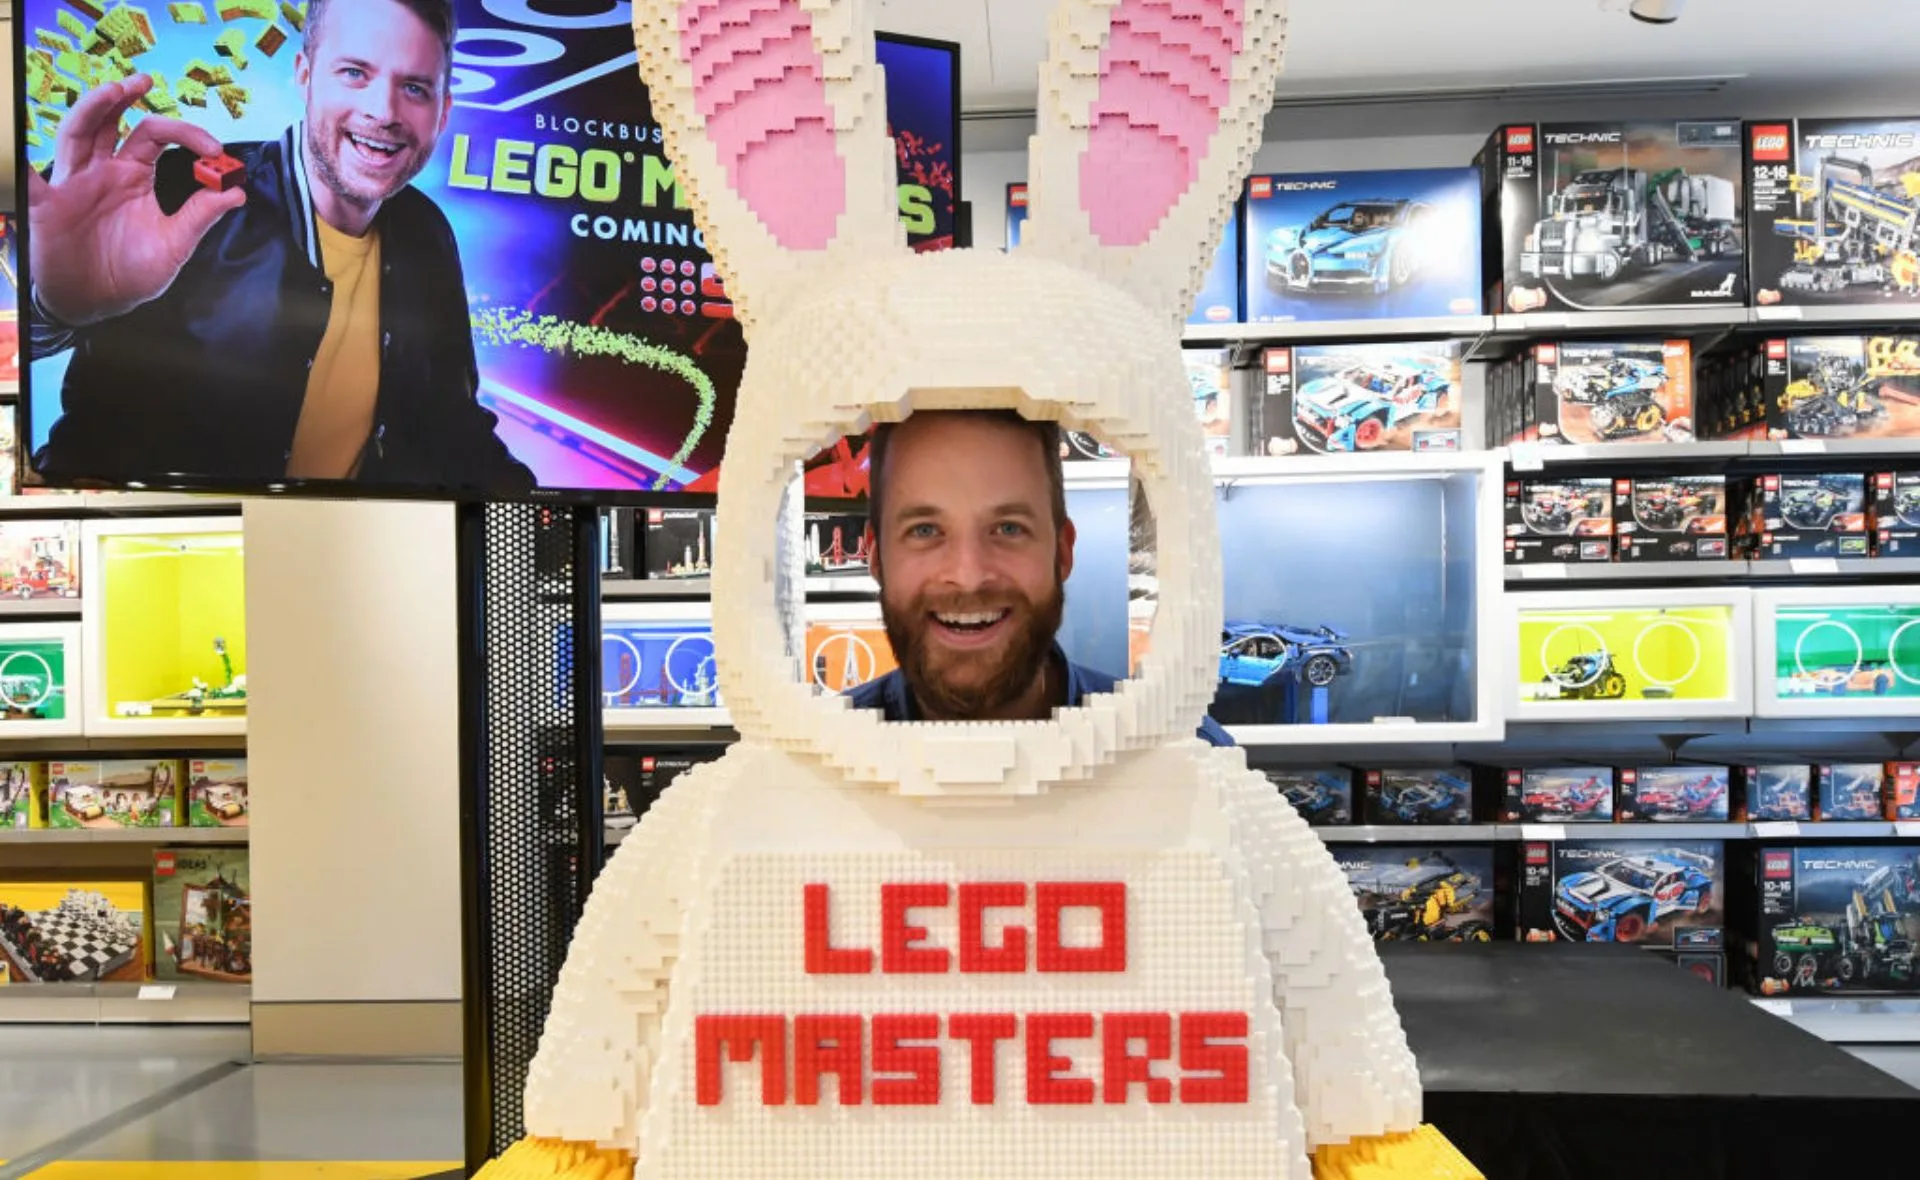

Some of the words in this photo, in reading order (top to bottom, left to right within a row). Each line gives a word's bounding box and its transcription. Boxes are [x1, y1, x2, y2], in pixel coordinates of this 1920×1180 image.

[1544, 132, 1622, 144] TECHNIC
[1756, 136, 1785, 149] LEGO
[1805, 133, 1914, 149] TECHNIC
[1506, 155, 1534, 167] 11-16
[1752, 165, 1788, 180] 12-16
[1557, 849, 1622, 859] TECHNIC
[1802, 859, 1878, 870] TECHNIC
[1763, 880, 1792, 892] 10-16
[804, 882, 1126, 974] LEGO
[696, 1012, 1249, 1105] MASTERS
